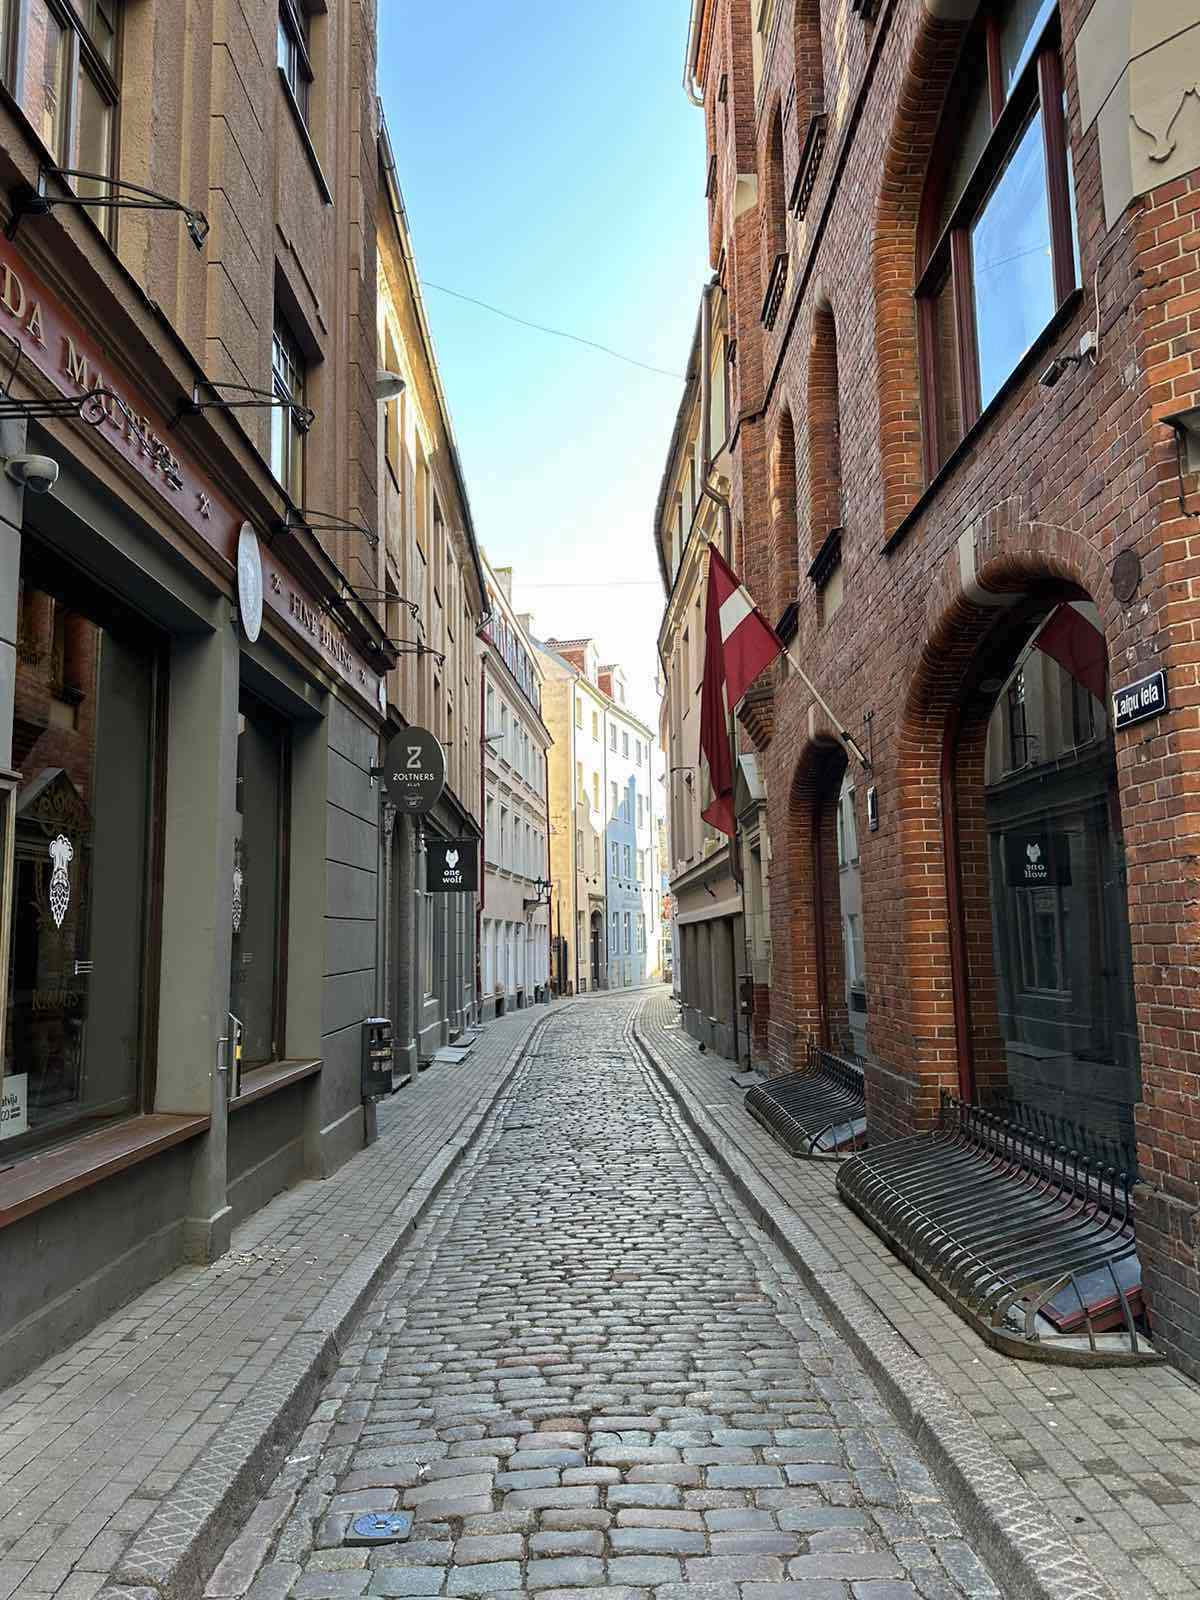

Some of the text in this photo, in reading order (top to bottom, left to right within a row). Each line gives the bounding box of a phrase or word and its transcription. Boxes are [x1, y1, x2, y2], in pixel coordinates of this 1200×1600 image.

[320, 624, 352, 672] DINING
[1115, 683, 1159, 718] Laipu iela
[442, 875, 462, 884] wolf
